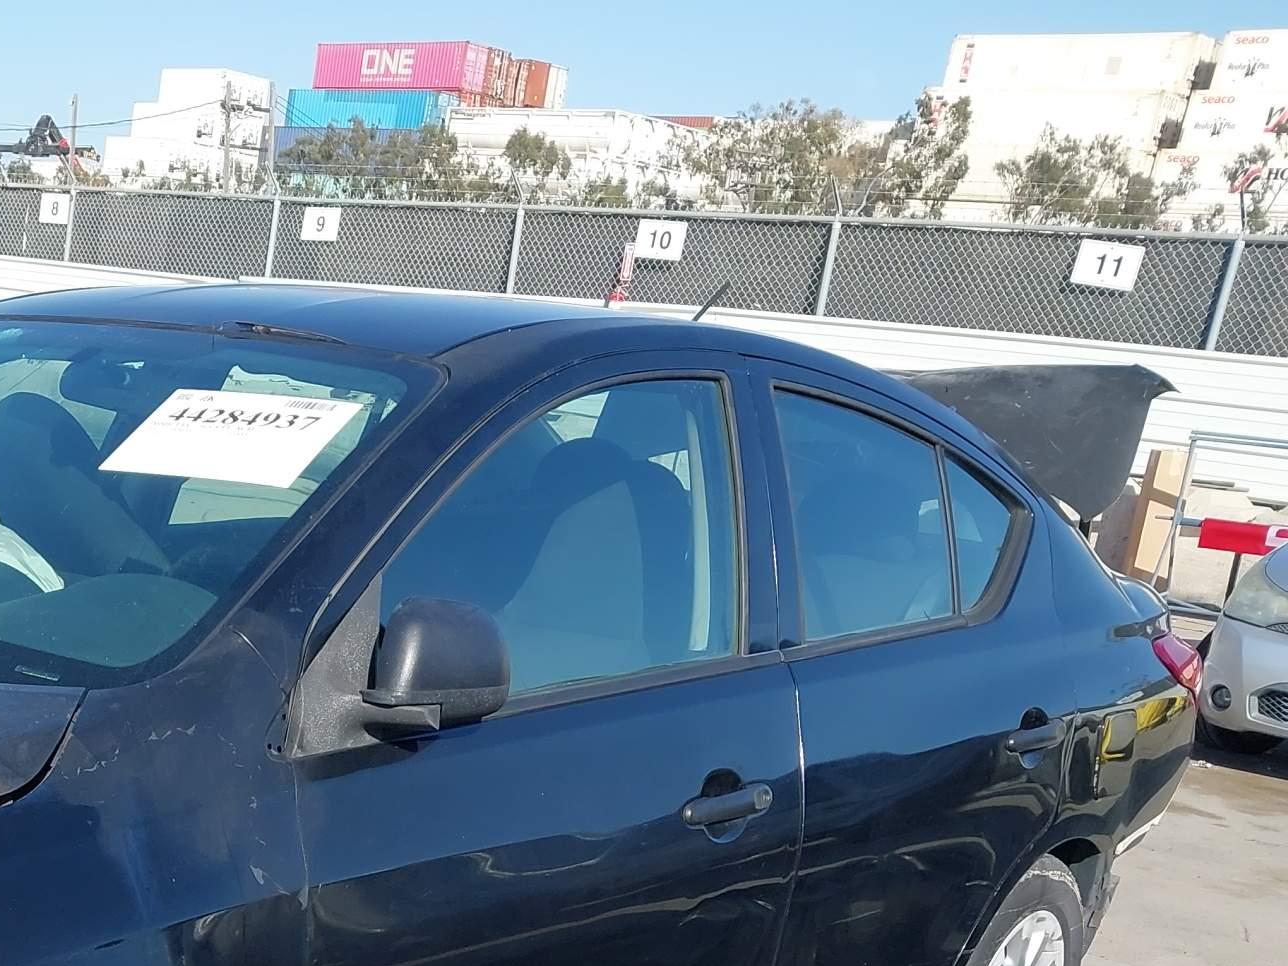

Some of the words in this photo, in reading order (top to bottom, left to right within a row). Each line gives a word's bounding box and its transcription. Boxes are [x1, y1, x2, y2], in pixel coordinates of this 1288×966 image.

[1234, 36, 1270, 45] seaco
[360, 48, 416, 75] ONE
[1201, 96, 1235, 104] seaco
[52, 201, 59, 216] 8
[316, 216, 325, 232] 9
[650, 229, 672, 250] 10
[1096, 253, 1123, 277] 11
[168, 406, 321, 431] 44284937
